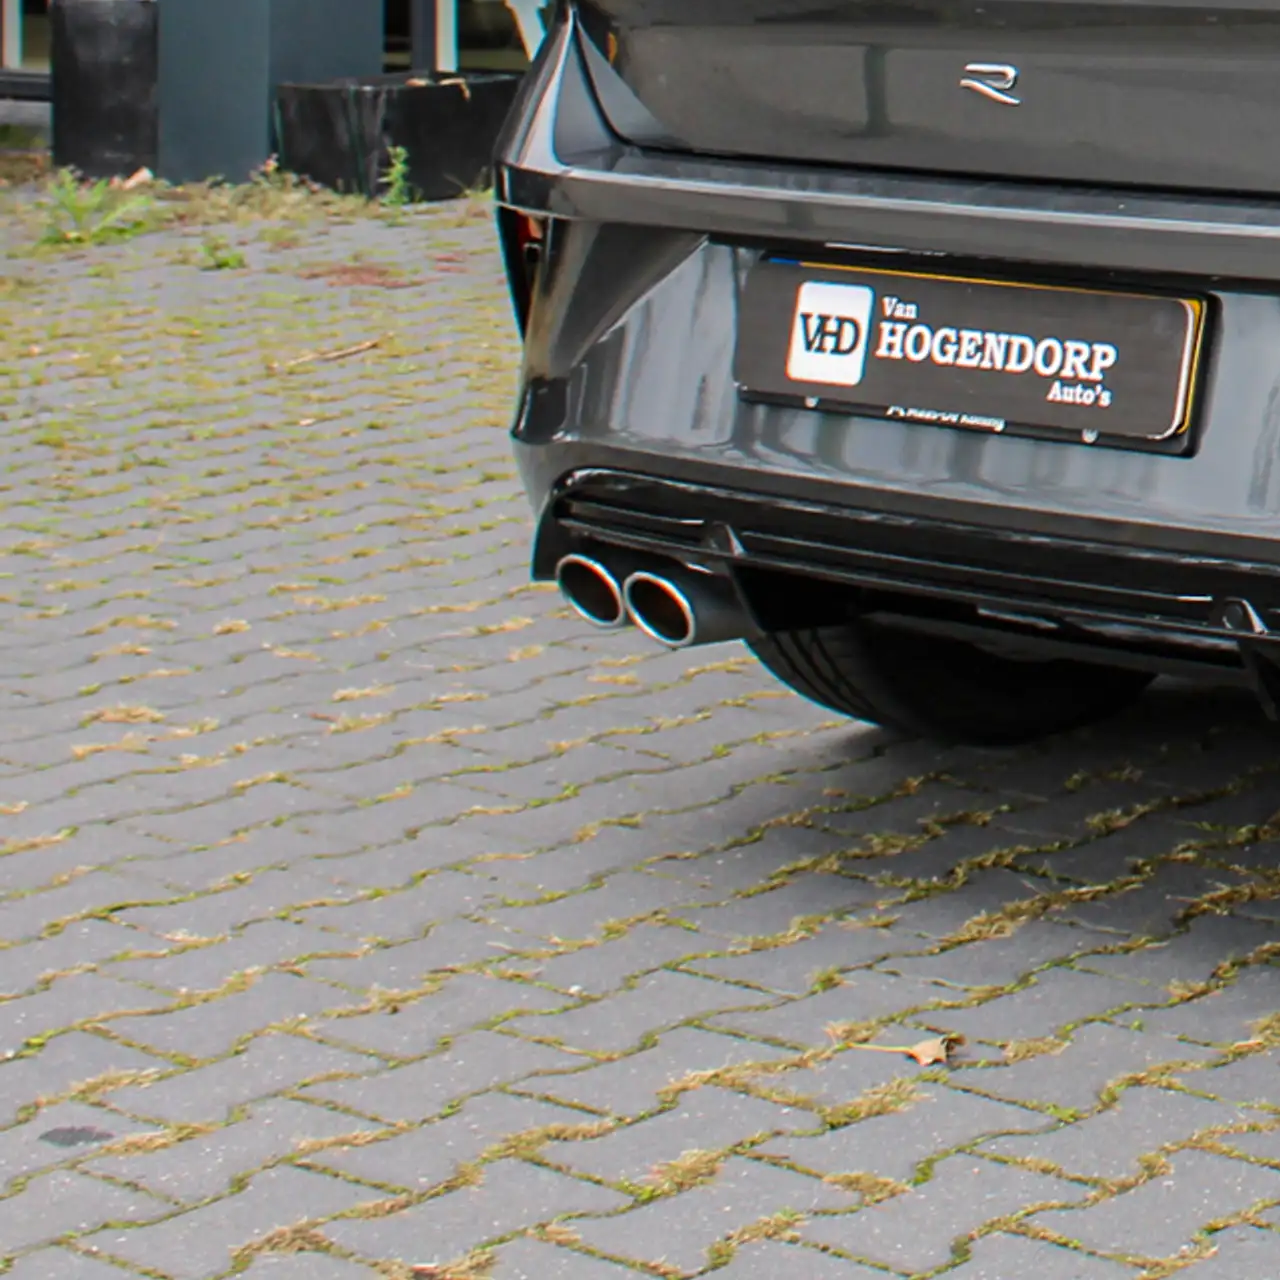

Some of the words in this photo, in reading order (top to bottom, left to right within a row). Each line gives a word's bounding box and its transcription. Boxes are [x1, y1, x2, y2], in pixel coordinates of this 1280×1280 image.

[882, 297, 917, 319] Van
[876, 321, 1117, 380] HOGENDORP
[1046, 380, 1112, 407] Auto's
